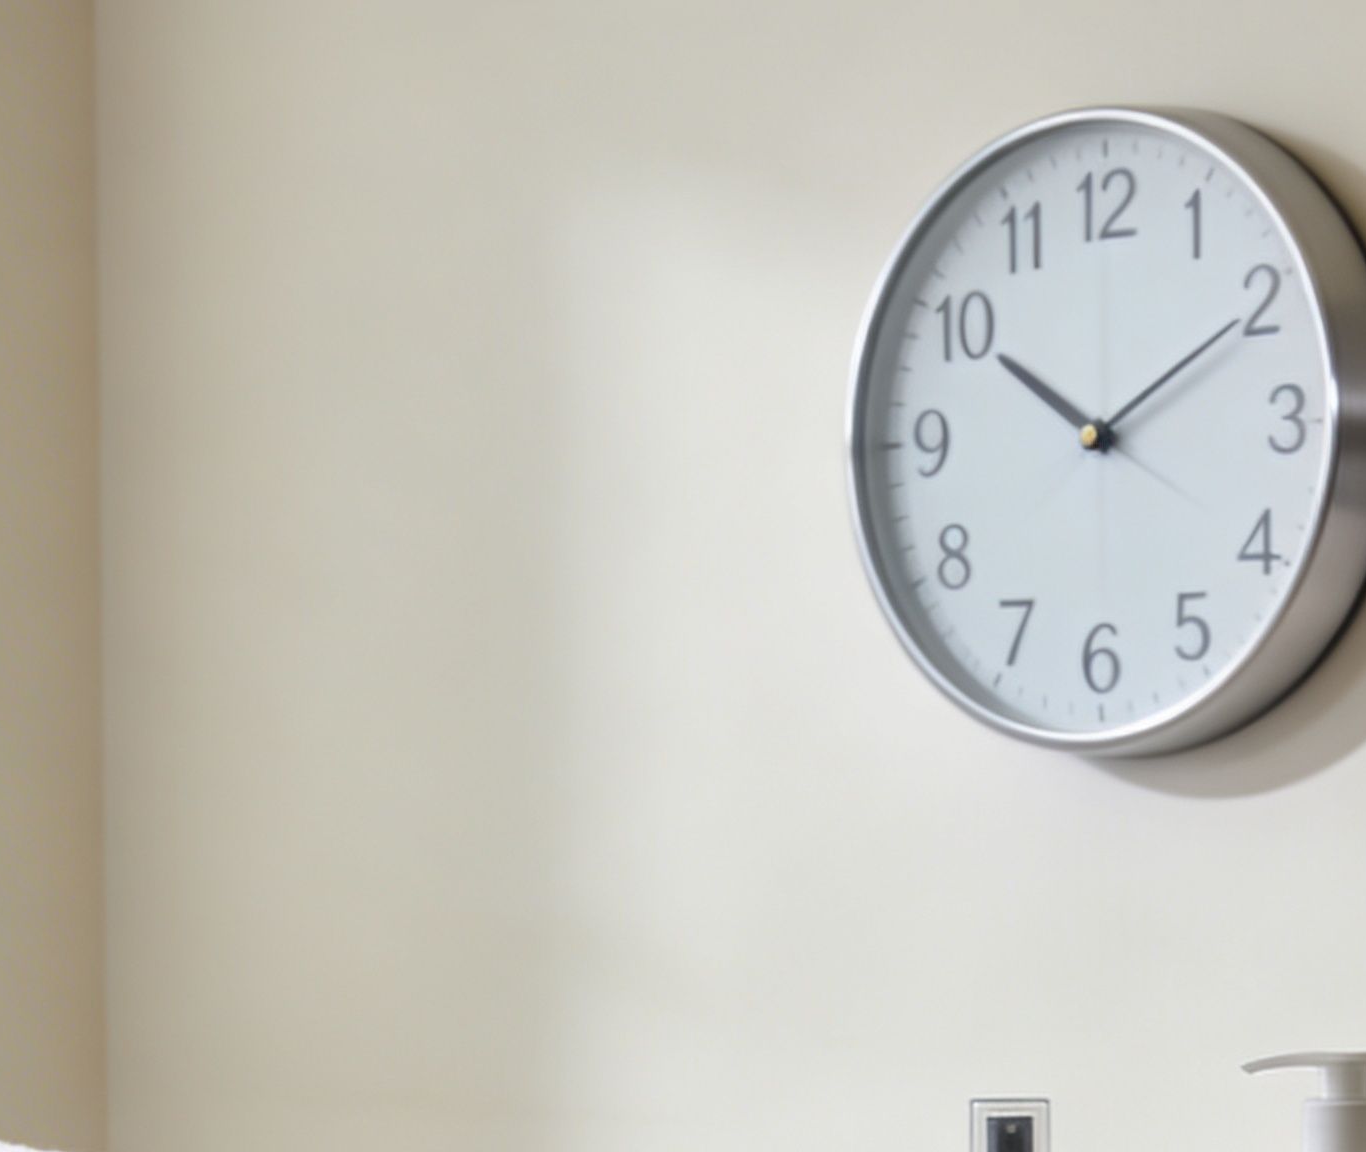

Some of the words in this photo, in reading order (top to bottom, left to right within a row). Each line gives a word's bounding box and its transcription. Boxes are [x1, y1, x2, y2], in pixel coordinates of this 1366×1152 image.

[1000, 199, 1043, 275] 11
[1075, 165, 1138, 243] 12
[1182, 187, 1202, 261] 1
[934, 290, 996, 363] 10
[1241, 263, 1283, 338] 2
[912, 408, 951, 478] 9
[1267, 383, 1308, 455] 3
[936, 522, 973, 591] 8
[1236, 507, 1283, 577] 4
[998, 597, 1036, 668] 7
[1080, 622, 1122, 695] 6
[1174, 590, 1212, 662] 5
